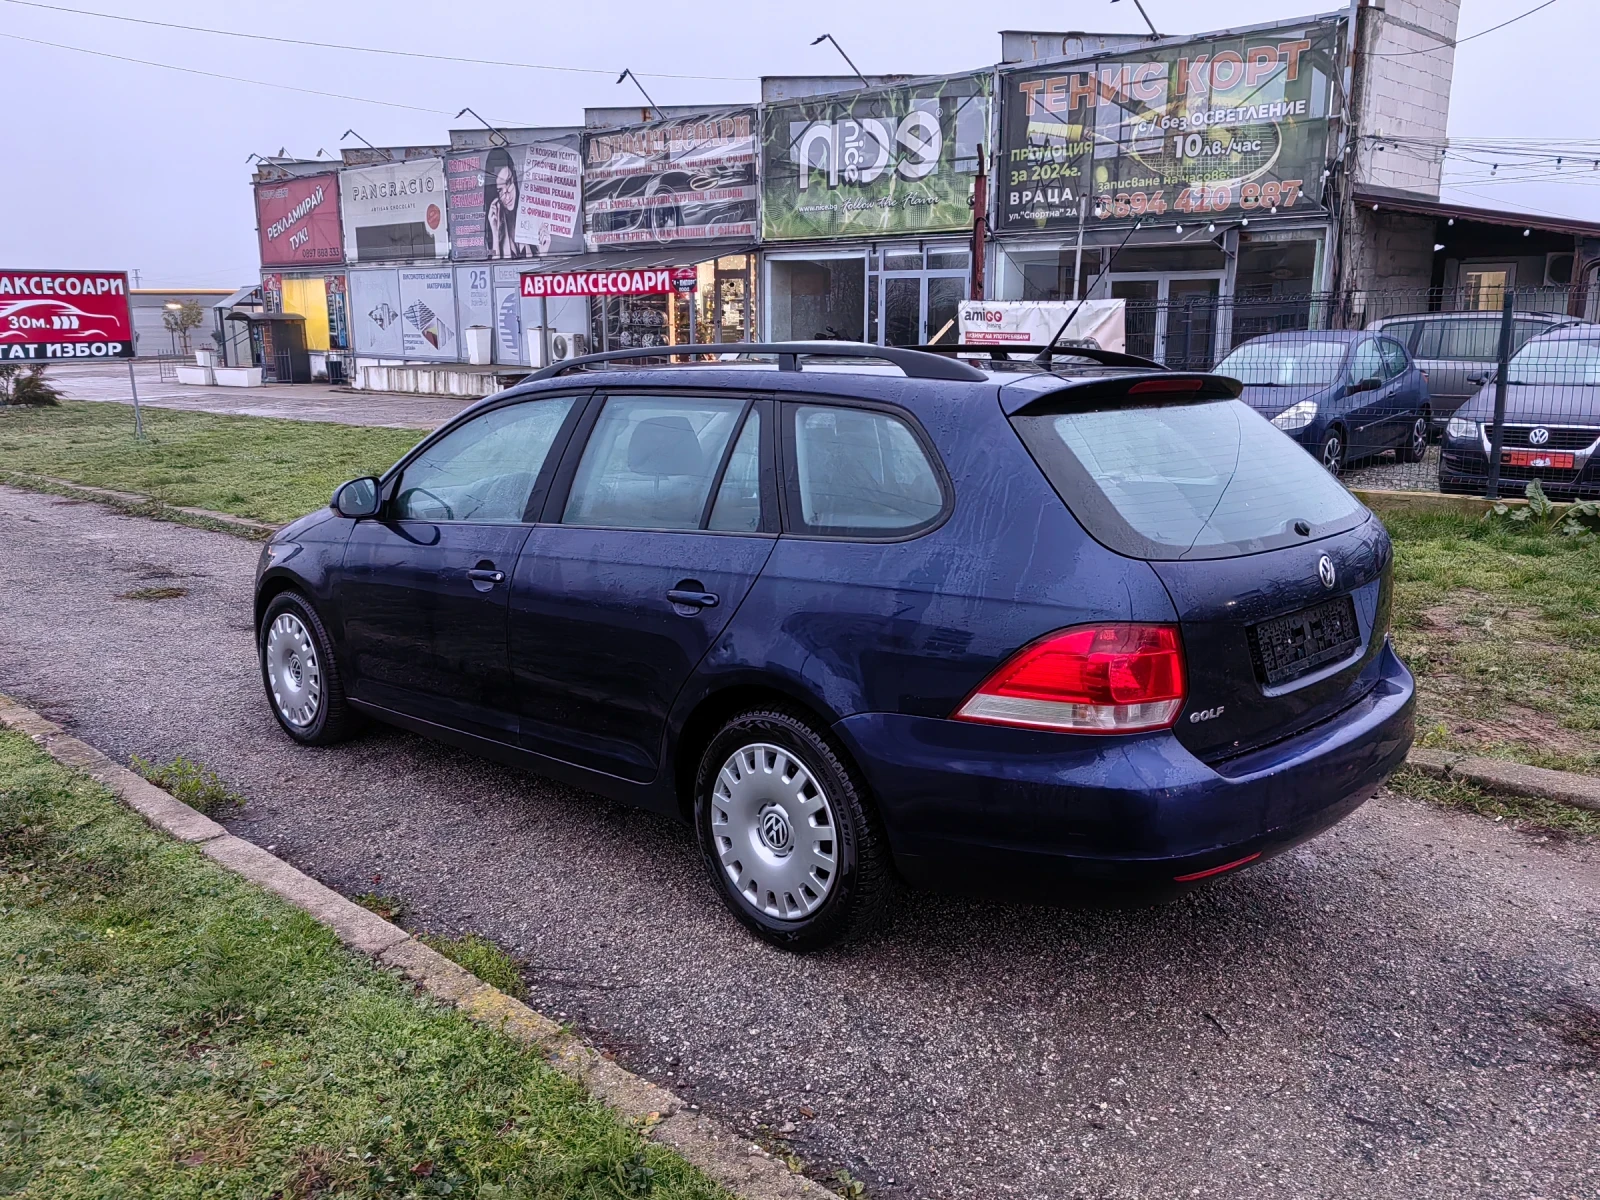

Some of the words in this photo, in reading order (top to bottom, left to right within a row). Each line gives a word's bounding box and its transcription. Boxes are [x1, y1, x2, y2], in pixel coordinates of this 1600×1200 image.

[1019, 61, 1163, 117] ТЕНИС
[1175, 38, 1311, 96] КОРТ
[1161, 113, 1189, 132] без
[1191, 99, 1306, 126] ОСВЕТЛЕНИЕ
[587, 115, 750, 164] АВТОАКСЕСОАРИ
[1011, 141, 1093, 162] ПРОМОЦИЯ
[1010, 170, 1029, 186] за
[1031, 162, 1082, 181] 2024г.
[1098, 173, 1161, 192] записване
[1163, 173, 1178, 185] на
[1181, 168, 1231, 184] часове:
[352, 177, 434, 201] PANCRACIO
[1009, 187, 1080, 206] ВРАЦА,
[1098, 189, 1167, 220] 0894
[1174, 185, 1232, 213] 420
[1239, 179, 1303, 209] 887
[267, 185, 324, 241] РЕКЛАМИРАЙ
[390, 202, 416, 211] CHOCOLATE
[798, 203, 838, 213] www.nice.bg
[841, 197, 875, 214] Follow
[876, 195, 897, 208] the
[901, 191, 941, 209] Flavor
[289, 227, 309, 250] ТУК!
[0, 276, 124, 295] АКСЕСОАРИ
[469, 270, 487, 290] 25
[524, 271, 670, 295] АВТОАКСЕСОАРИ
[46, 342, 122, 357] ИЗБОР
[1189, 705, 1225, 724] GOLF
